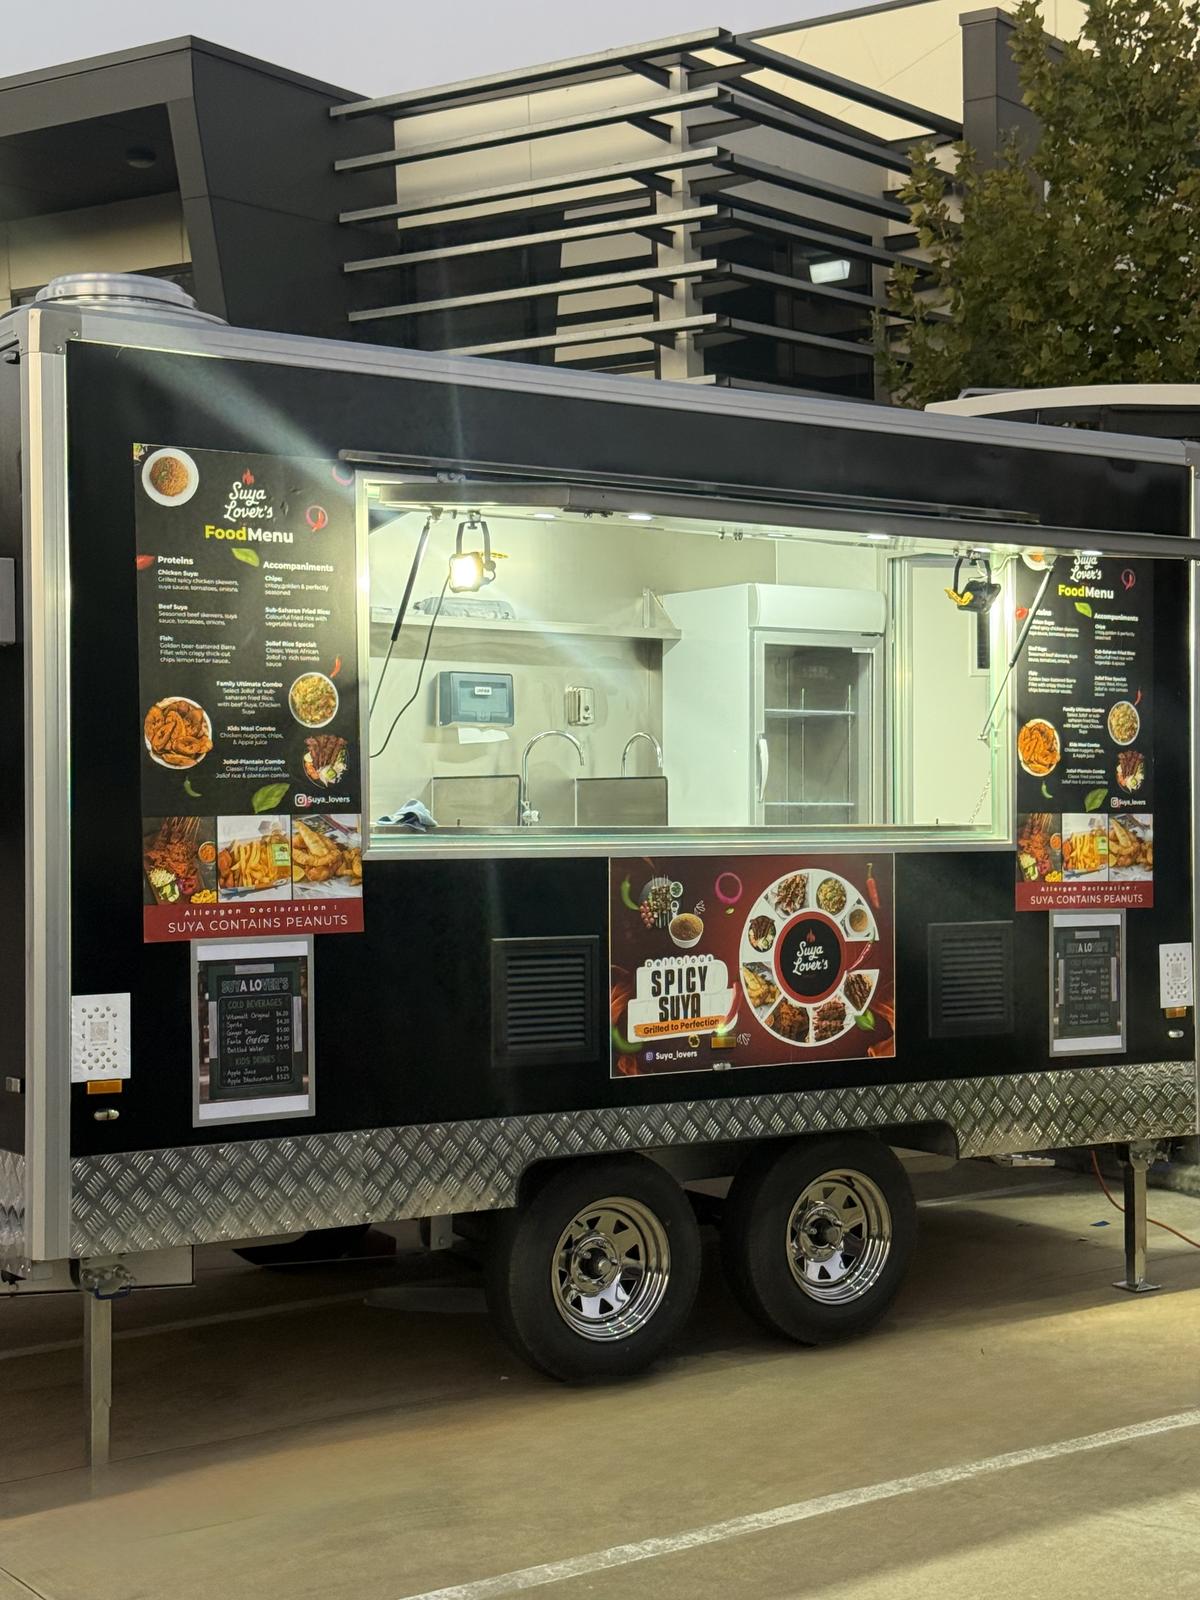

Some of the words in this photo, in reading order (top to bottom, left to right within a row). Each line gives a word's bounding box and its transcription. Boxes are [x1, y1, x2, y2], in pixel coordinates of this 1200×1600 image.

[229, 481, 267, 506] Suya
[223, 500, 273, 522] Lover's
[158, 556, 194, 565] Proteins
[263, 561, 334, 572] Accompaniments
[1074, 553, 1098, 570] Suya
[158, 569, 183, 577] Chicken
[1070, 566, 1103, 583] Lover's
[305, 584, 329, 592] perfectly
[264, 606, 302, 615] Sub-Saharan
[302, 607, 316, 615] Fried
[265, 613, 290, 621] Colourful
[1094, 612, 1139, 622] Accompaniments
[284, 647, 299, 655] West
[299, 648, 320, 656] African
[307, 795, 351, 805] Suya_lovers
[1030, 895, 1054, 905] SUYA
[1056, 894, 1102, 904] CONTAINS
[1104, 893, 1144, 903] PEANUTS
[185, 907, 242, 917] Allergen
[249, 903, 327, 915] Declaration
[168, 919, 205, 933] SUYA
[210, 916, 282, 931] CONTAINS
[287, 914, 349, 928] PEANUTS
[797, 940, 824, 963] Suya
[793, 958, 829, 975] Lover's
[651, 965, 709, 997] SPICY
[658, 993, 702, 1022] SUYA
[643, 1025, 670, 1034] Grilled
[671, 1023, 680, 1031] to
[680, 1018, 720, 1029] Perfection
[655, 1050, 698, 1061] Suya_lovers
